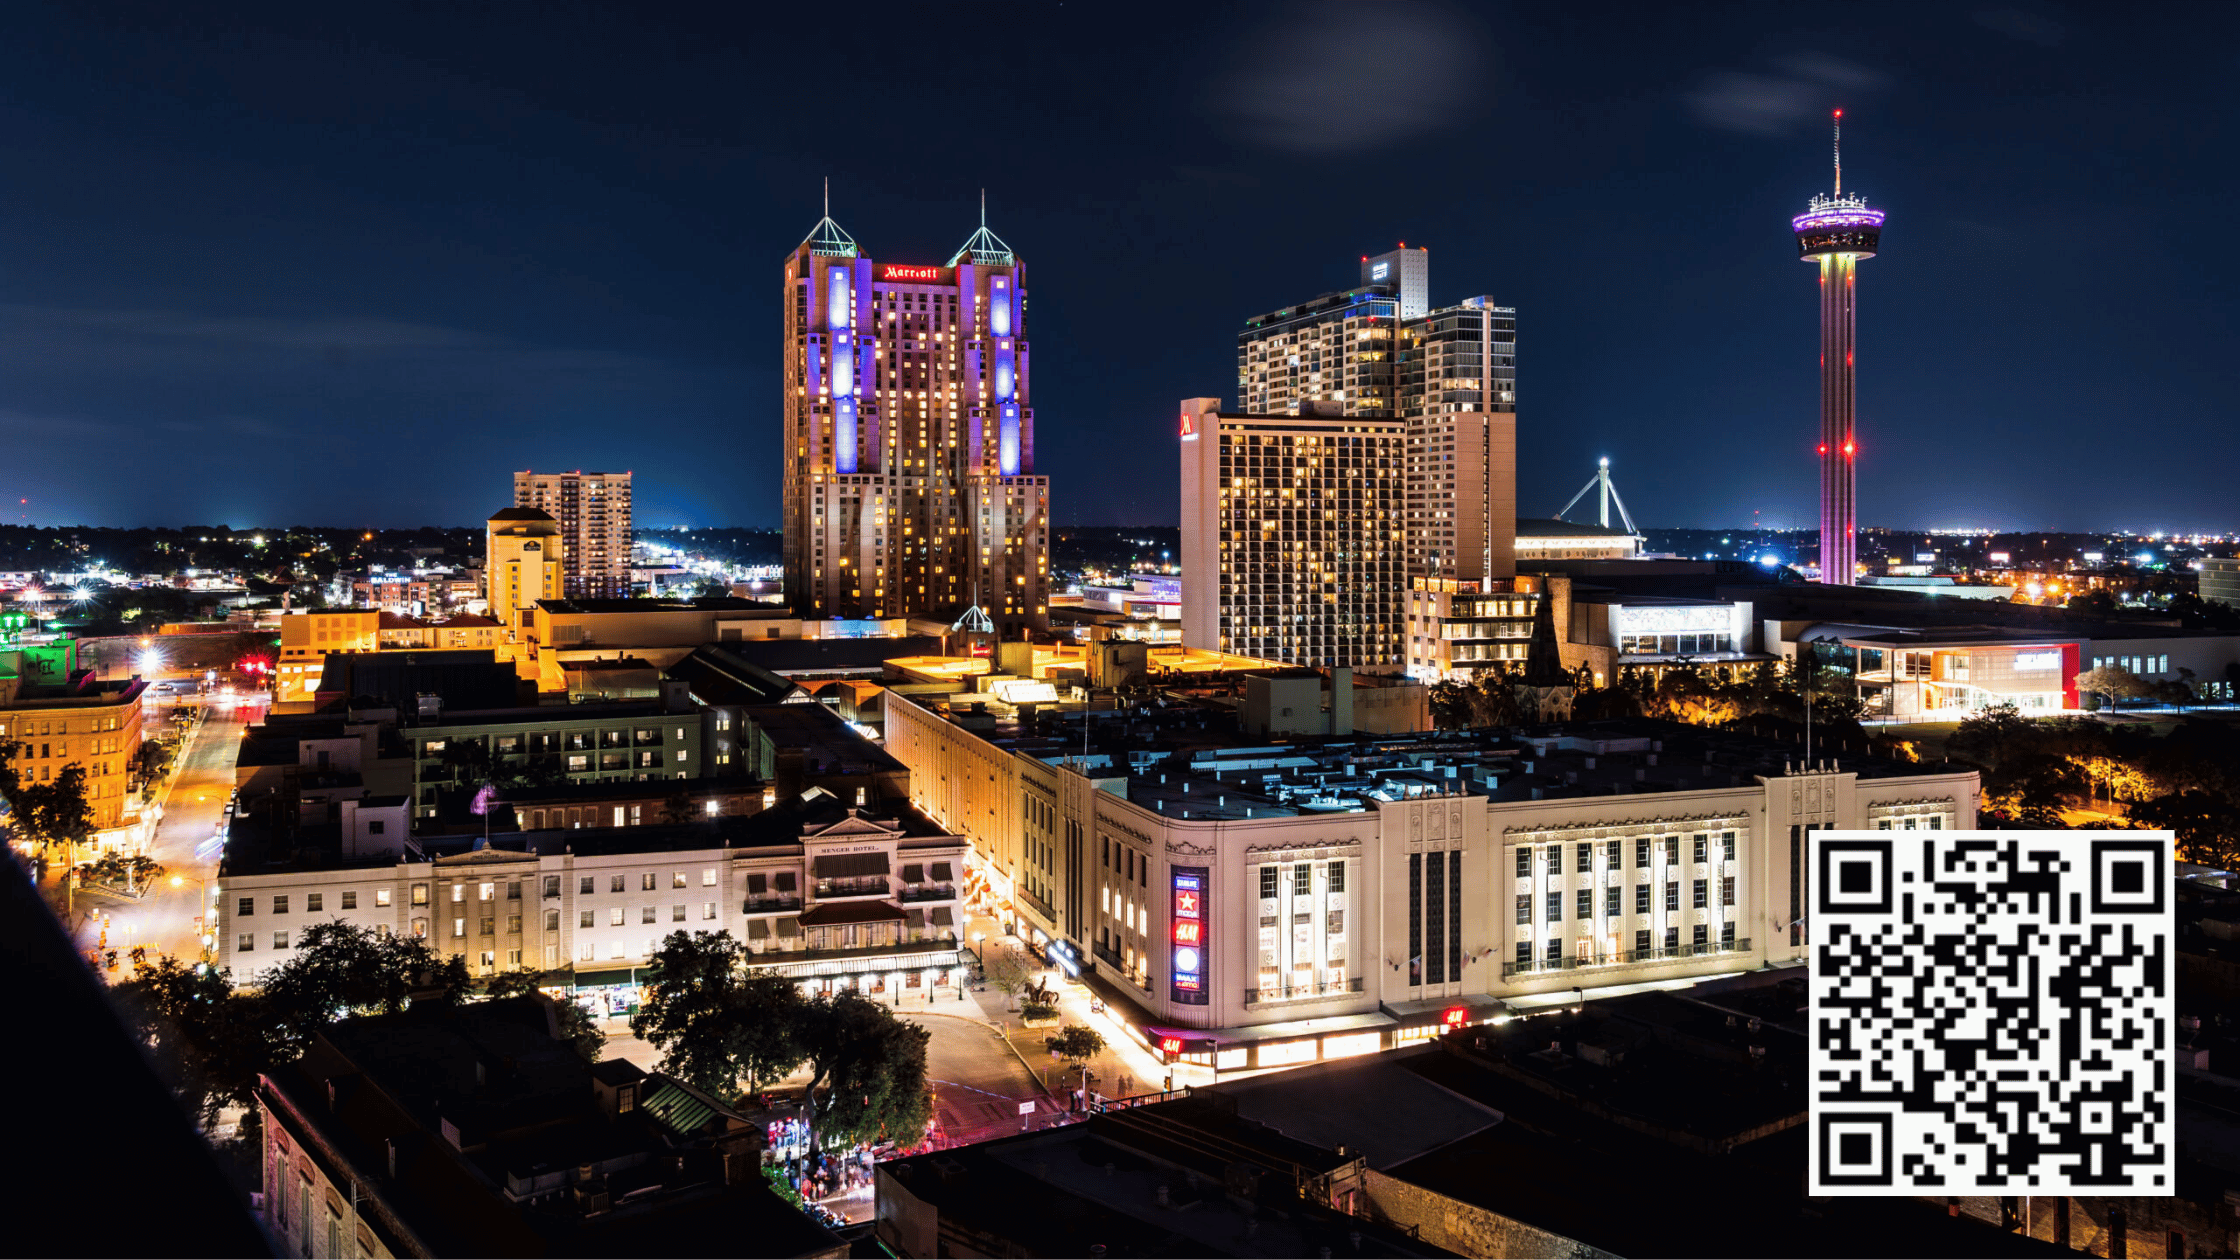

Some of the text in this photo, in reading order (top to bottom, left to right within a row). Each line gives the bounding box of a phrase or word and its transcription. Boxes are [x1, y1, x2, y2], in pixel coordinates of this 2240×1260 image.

[884, 266, 938, 278] Marriott
[370, 576, 411, 584] BALDWIN
[1175, 924, 1199, 942] H&M
